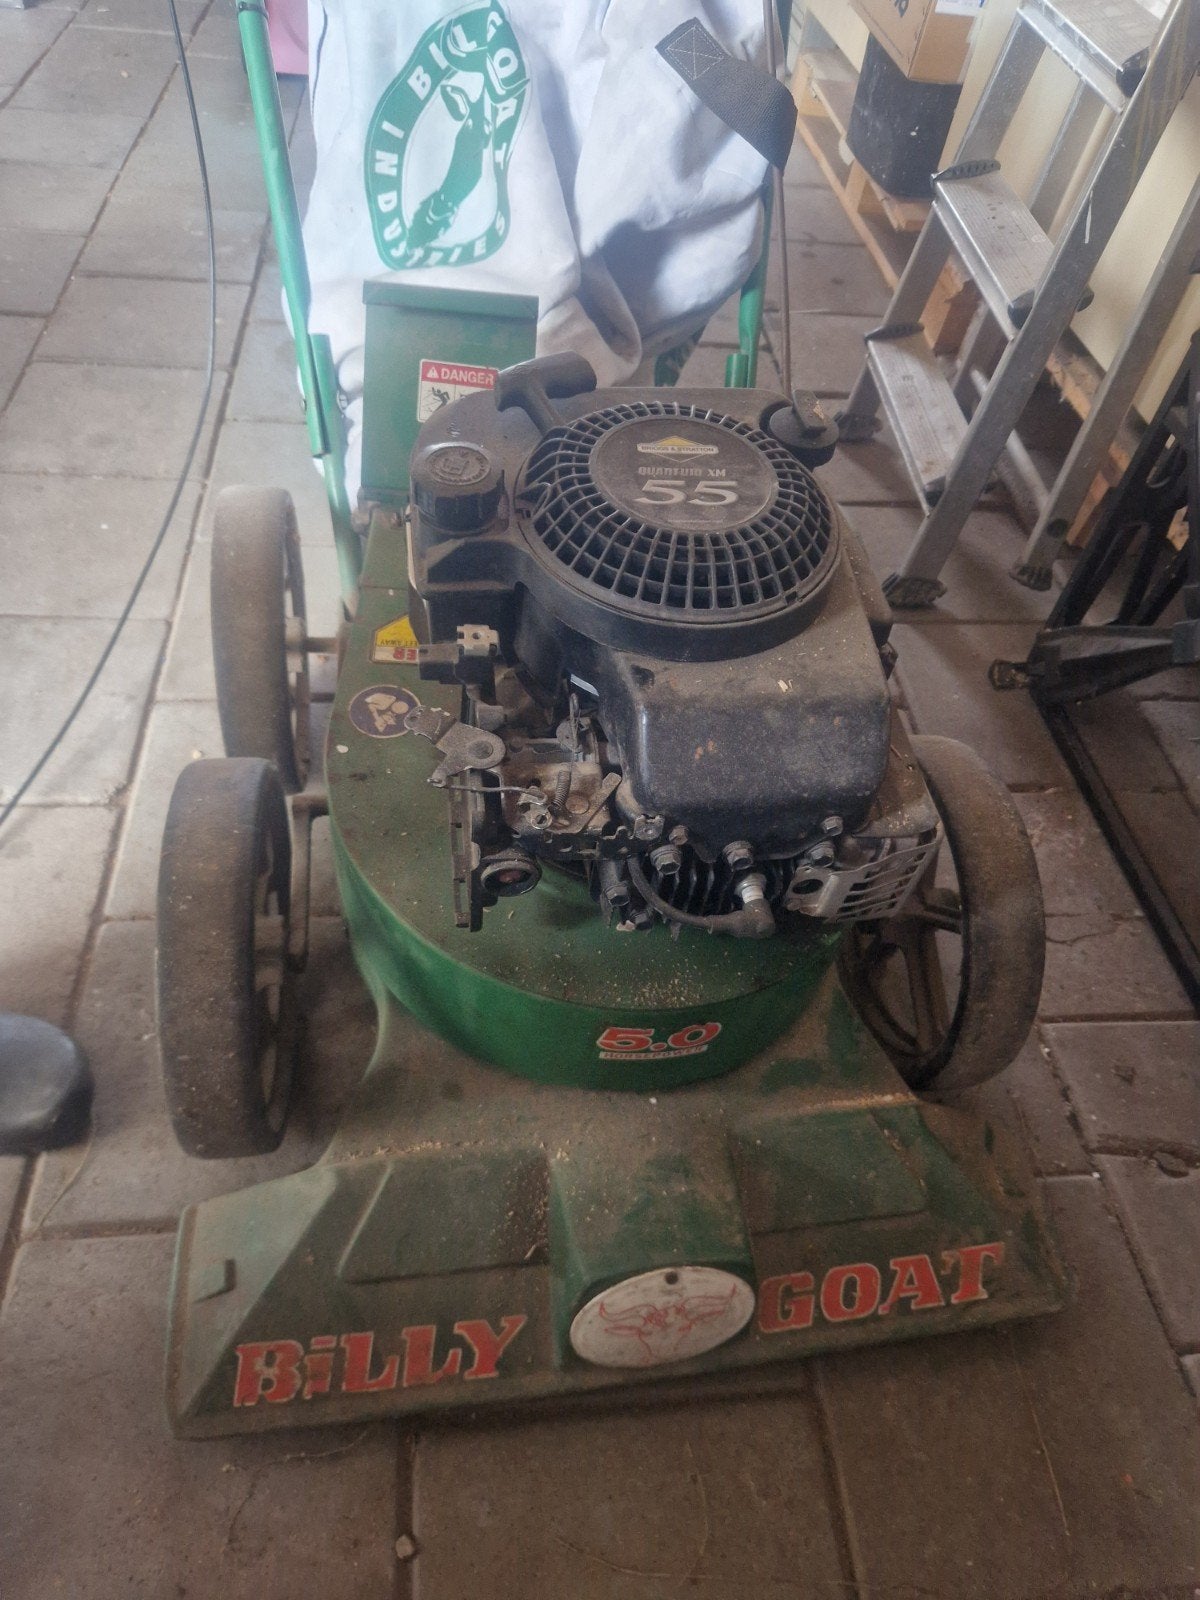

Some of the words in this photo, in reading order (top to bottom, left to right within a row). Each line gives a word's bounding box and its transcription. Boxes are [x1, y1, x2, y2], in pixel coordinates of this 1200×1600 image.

[440, 368, 495, 386] DANGER
[707, 468, 726, 477] XM
[632, 479, 739, 506] 55
[596, 1022, 722, 1052] 5.0
[758, 1242, 1005, 1333] GOAT
